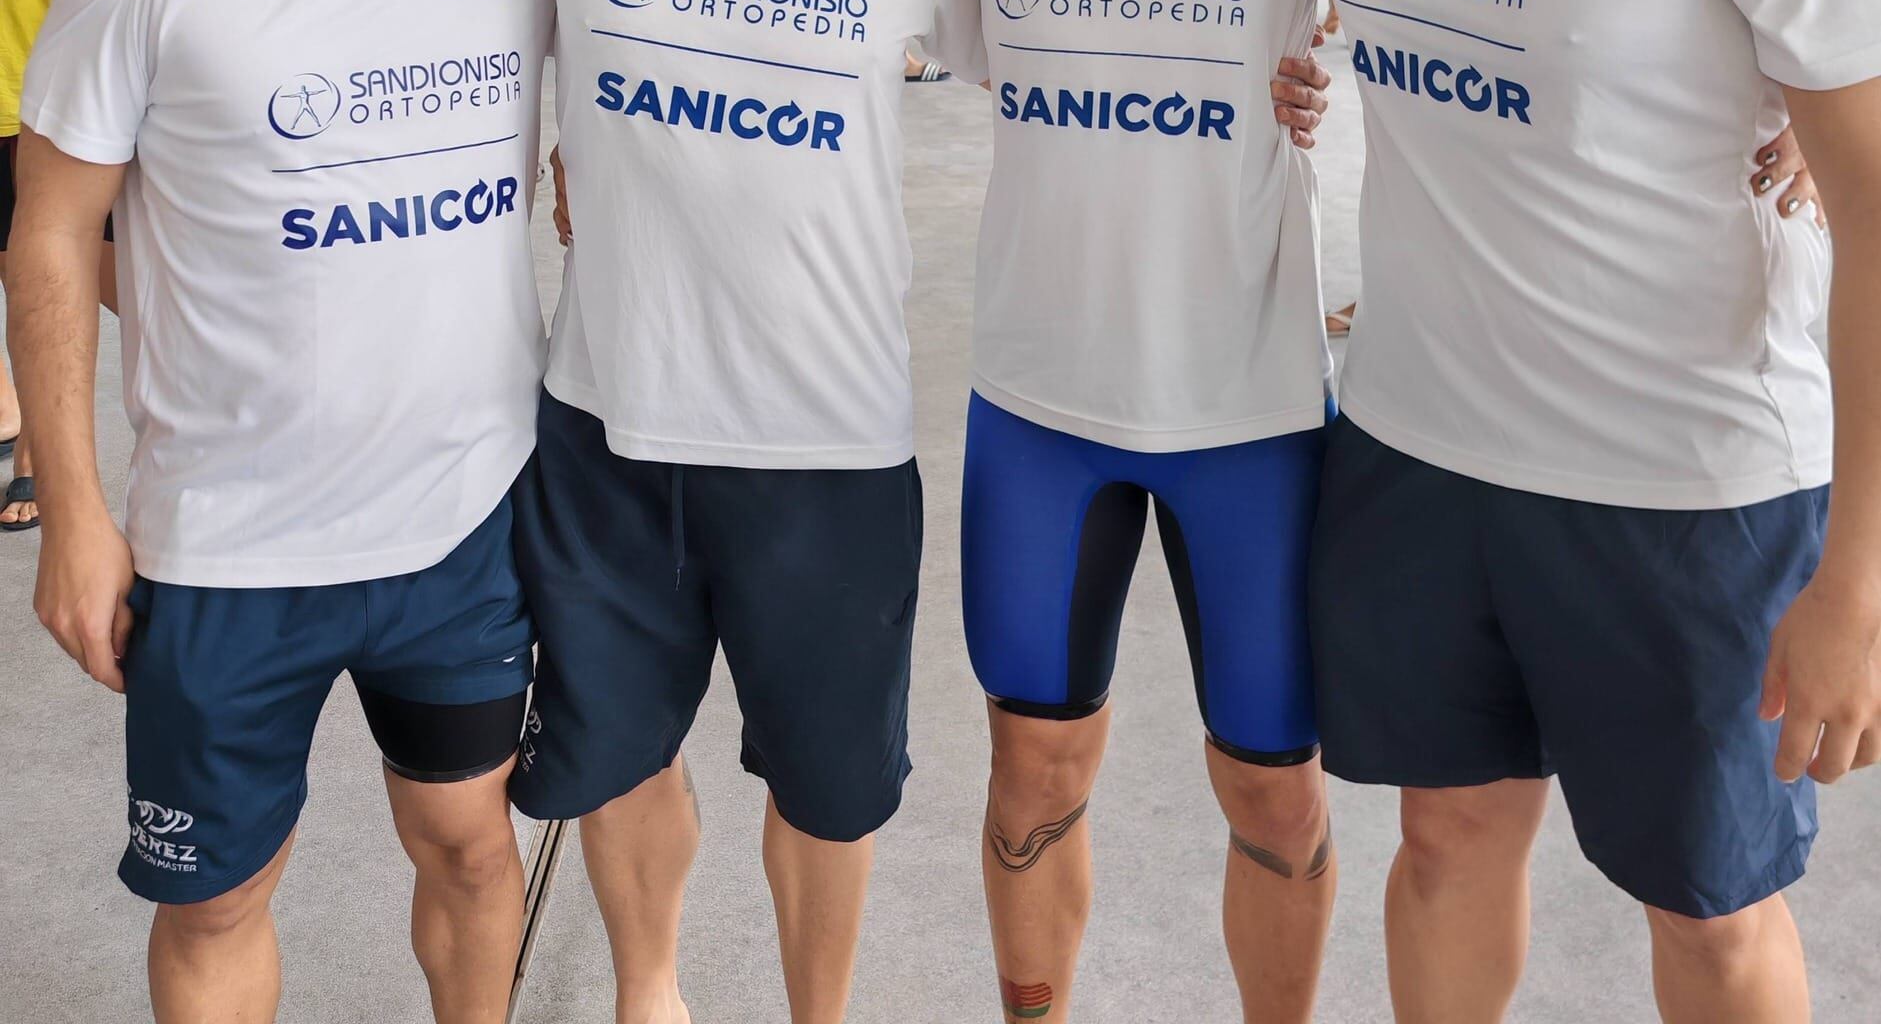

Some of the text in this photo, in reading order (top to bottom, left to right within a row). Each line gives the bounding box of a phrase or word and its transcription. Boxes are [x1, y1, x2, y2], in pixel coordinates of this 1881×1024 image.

[350, 51, 521, 100] SANDIONISIO
[350, 81, 521, 125] ORTOPEDIA
[1352, 39, 1532, 126] ANICOR
[595, 71, 845, 151] SANICOR
[1000, 81, 1235, 141] SANICOR
[281, 176, 518, 250] SANICOR
[132, 822, 198, 862] JEREZ
